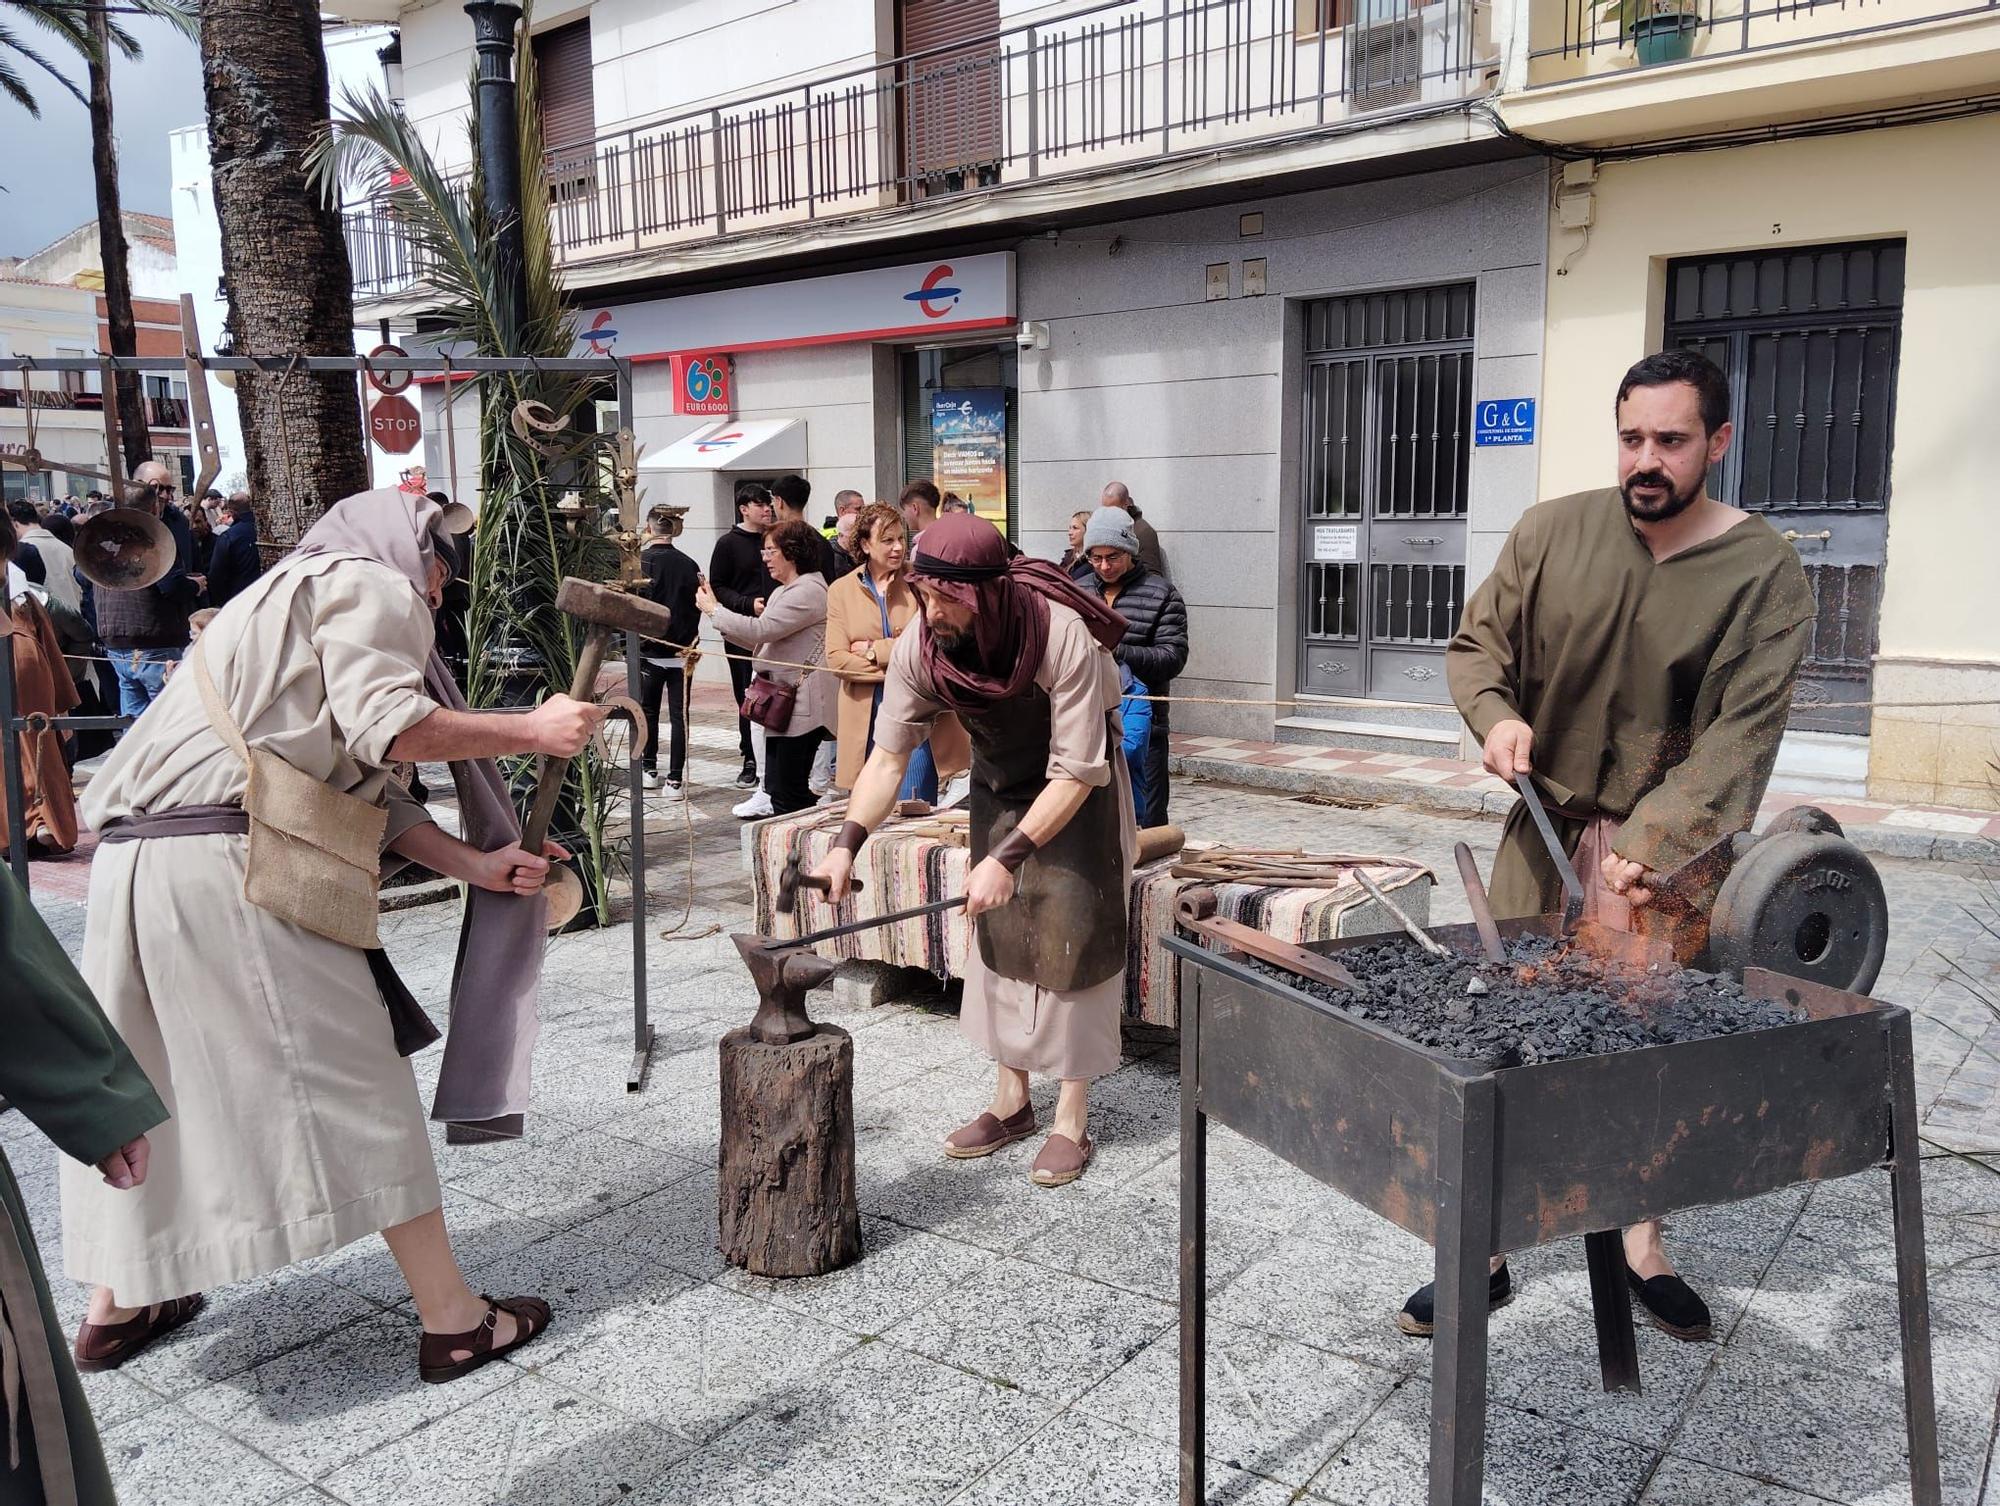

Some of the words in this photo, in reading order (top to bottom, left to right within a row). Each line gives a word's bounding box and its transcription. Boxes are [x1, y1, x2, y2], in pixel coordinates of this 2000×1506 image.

[686, 402, 706, 412] EURO
[707, 403, 728, 412] 6000
[1484, 403, 1498, 427] G
[1502, 413, 1510, 426] &
[1514, 401, 1527, 426] C
[374, 417, 417, 431] STOP
[958, 450, 977, 458] VAMOS
